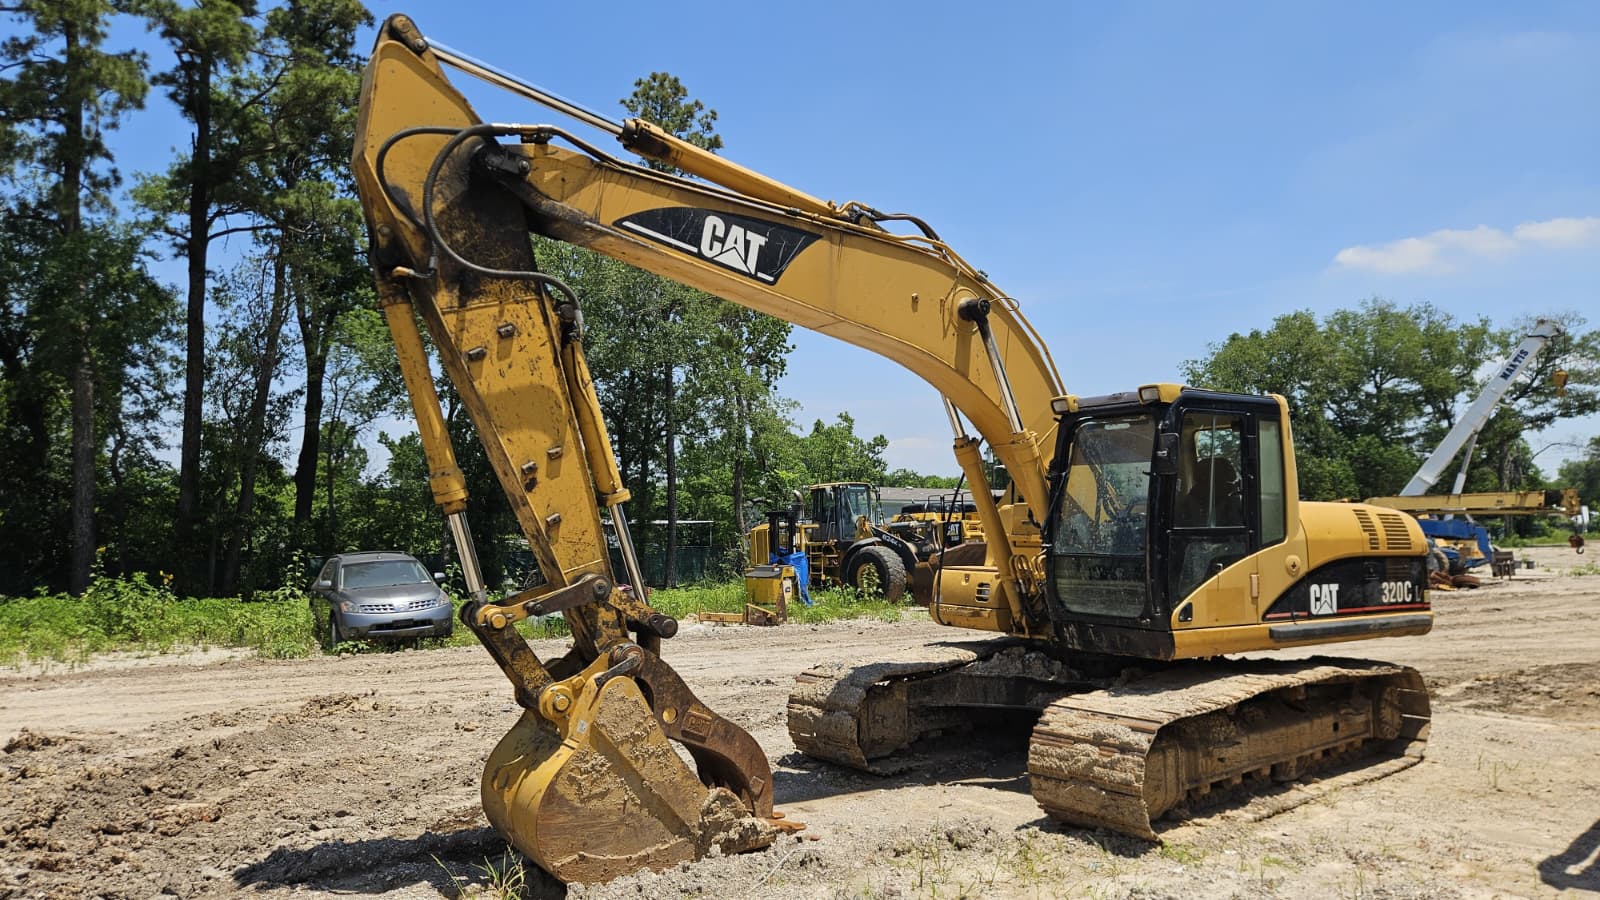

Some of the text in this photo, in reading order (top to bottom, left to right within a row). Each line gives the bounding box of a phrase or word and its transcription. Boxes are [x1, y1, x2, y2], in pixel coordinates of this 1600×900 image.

[701, 215, 768, 275] CAT
[1500, 349, 1529, 381] MANTIS
[1309, 583, 1340, 615] CAT
[1381, 580, 1422, 603] 320C L
